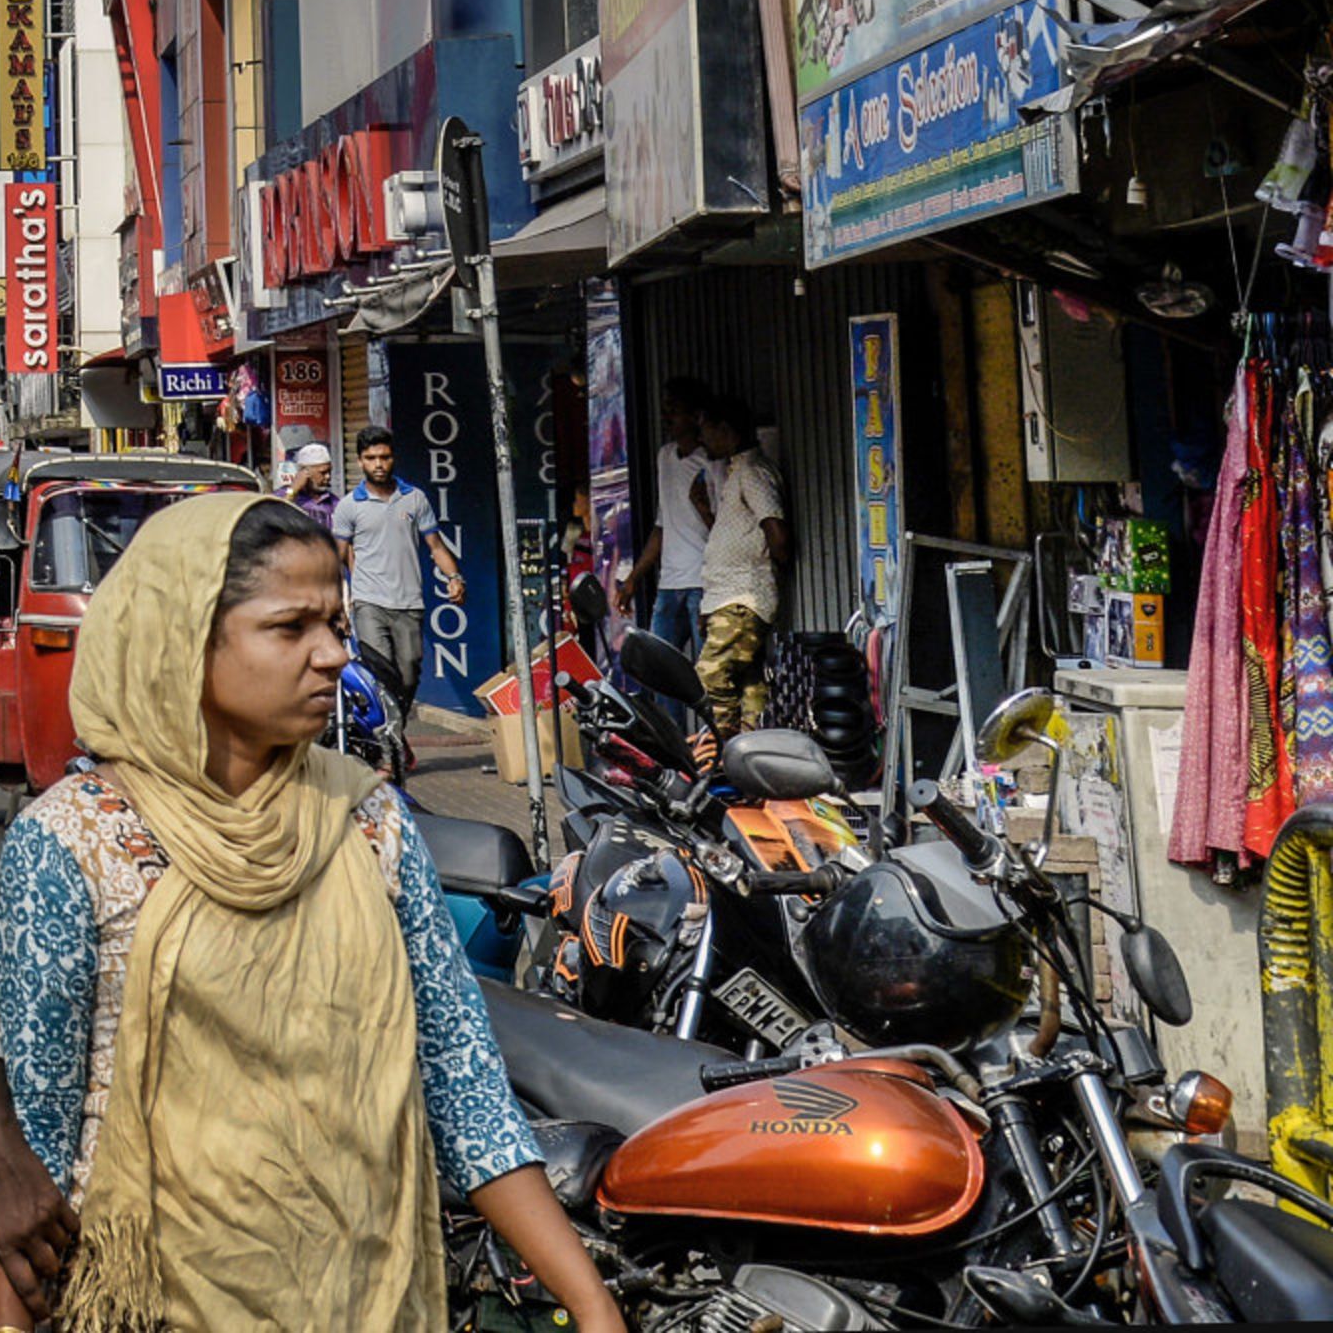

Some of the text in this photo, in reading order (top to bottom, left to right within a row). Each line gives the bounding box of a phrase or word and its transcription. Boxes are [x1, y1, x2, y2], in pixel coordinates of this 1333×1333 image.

[897, 42, 981, 154] Selection
[12, 188, 49, 369] saratha's
[282, 361, 322, 382] 186
[165, 373, 213, 392] Richi
[749, 1120, 854, 1136] HONDA
